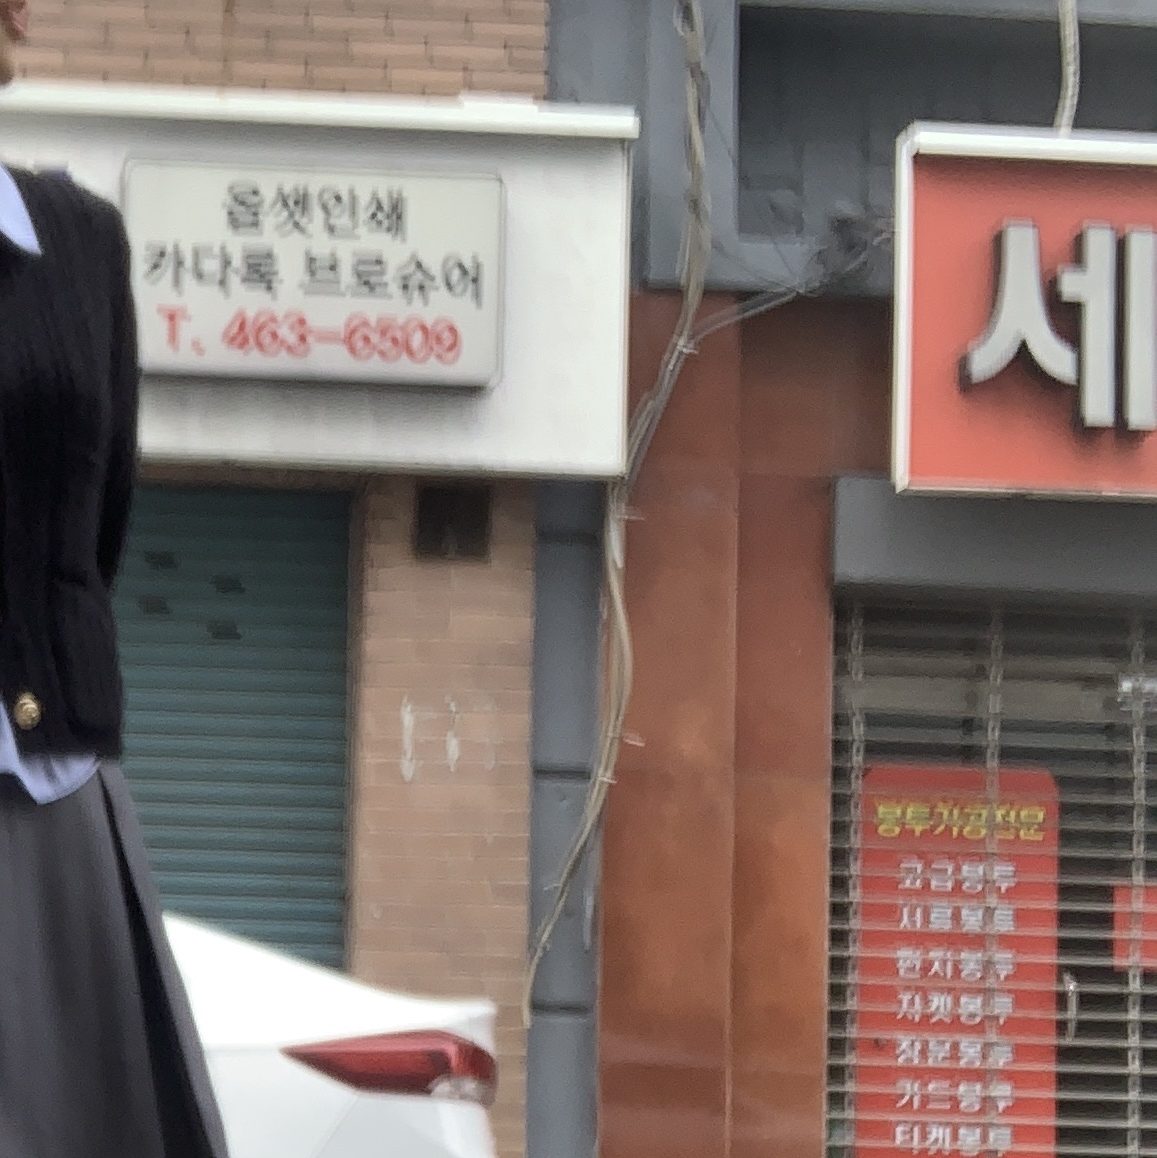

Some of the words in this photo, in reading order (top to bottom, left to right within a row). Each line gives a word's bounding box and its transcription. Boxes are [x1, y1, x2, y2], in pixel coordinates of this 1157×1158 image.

[145, 240, 280, 302] 카다록
[299, 245, 485, 309] 브로슈어
[222, 307, 463, 365] 463-6509
[968, 219, 1157, 430] 세
[898, 857, 1018, 894] 고급봉투
